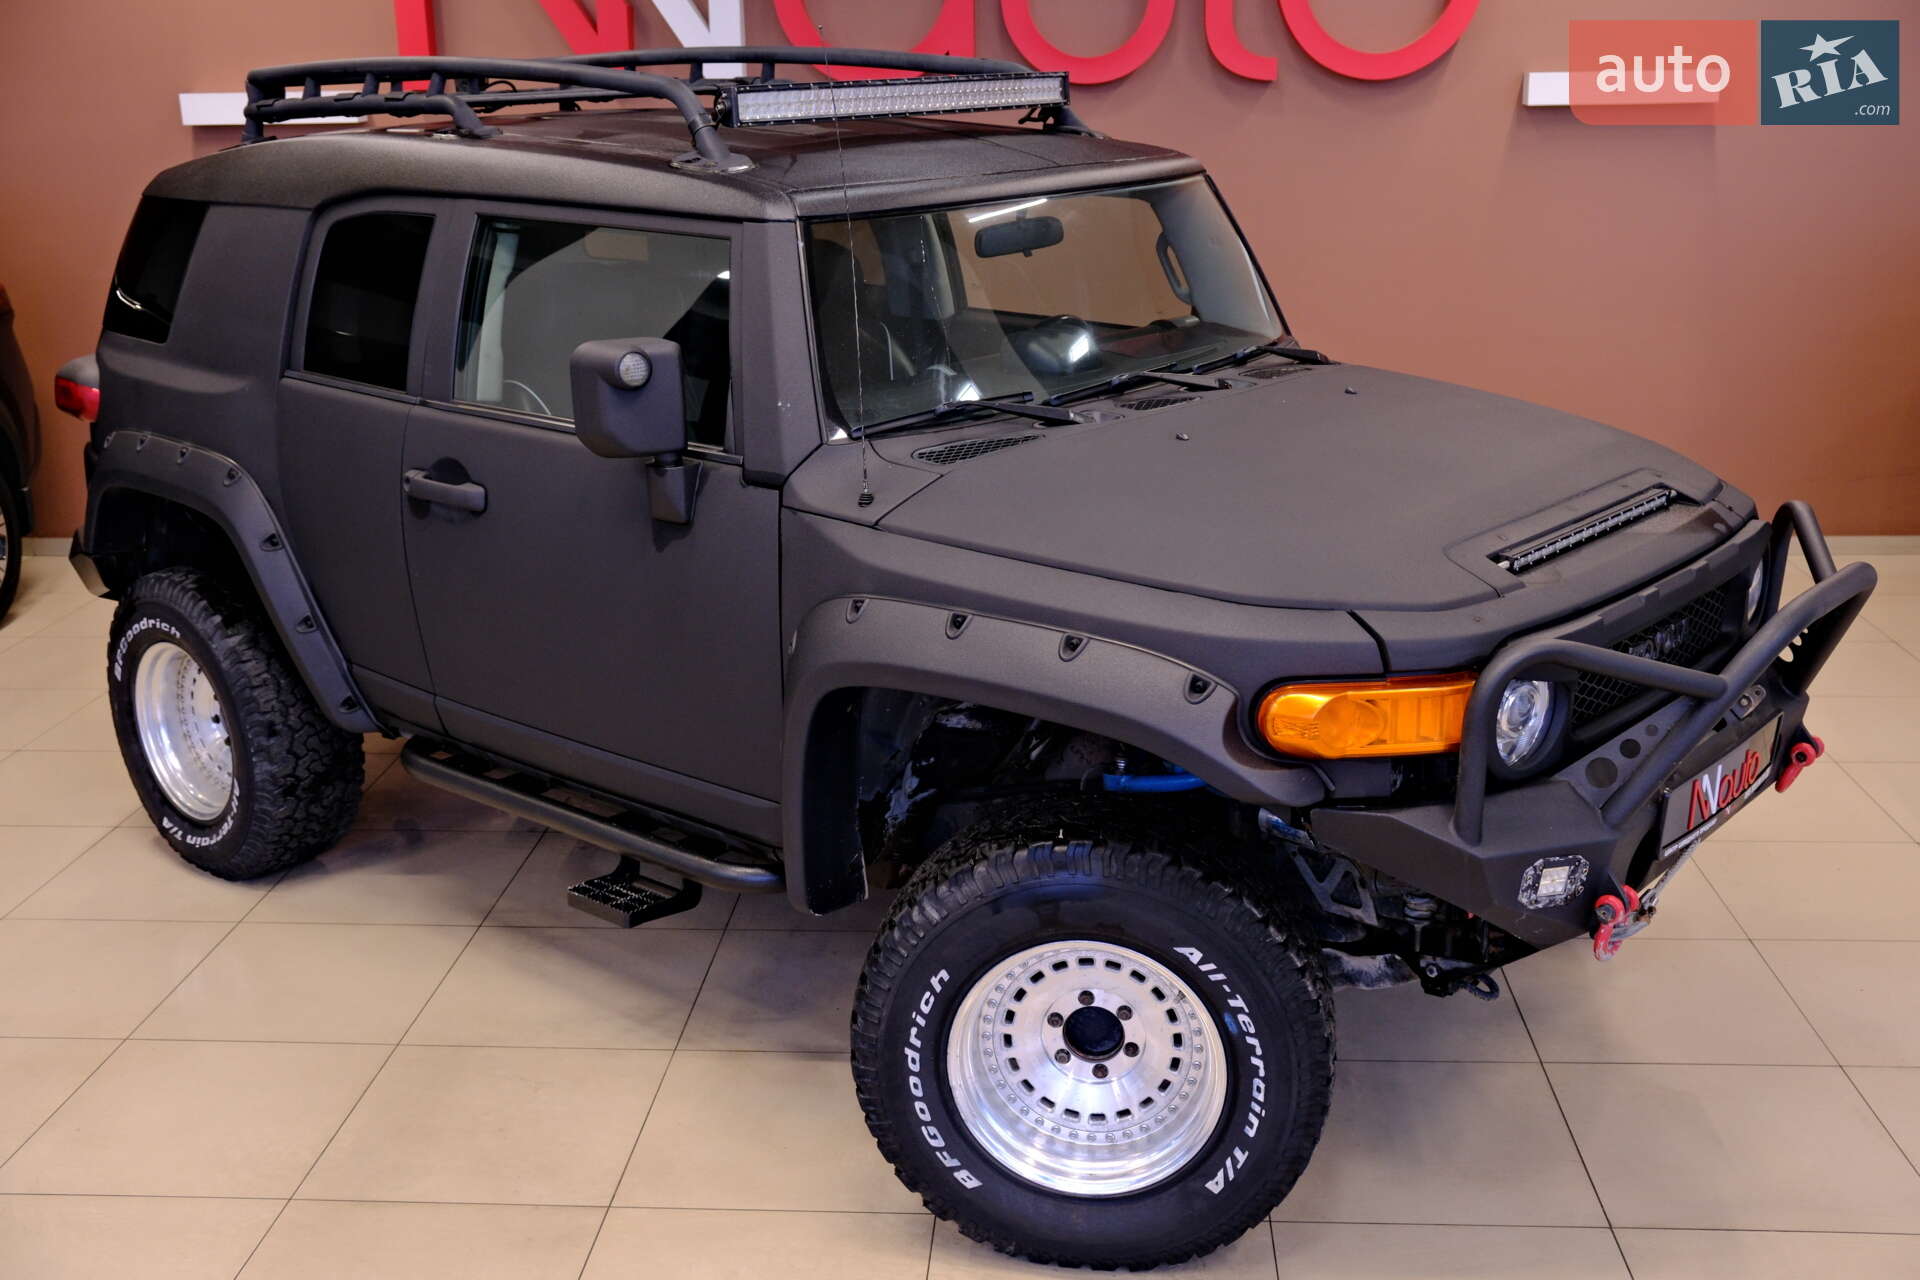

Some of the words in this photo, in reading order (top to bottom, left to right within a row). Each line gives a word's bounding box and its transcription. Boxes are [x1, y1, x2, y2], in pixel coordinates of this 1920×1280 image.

[114, 617, 181, 682] BFGoodrich
[162, 816, 183, 841] T/A
[1173, 946, 1266, 1138] All-Terrain
[904, 968, 984, 1190] BFGoodrich
[1204, 1146, 1249, 1195] T/A
